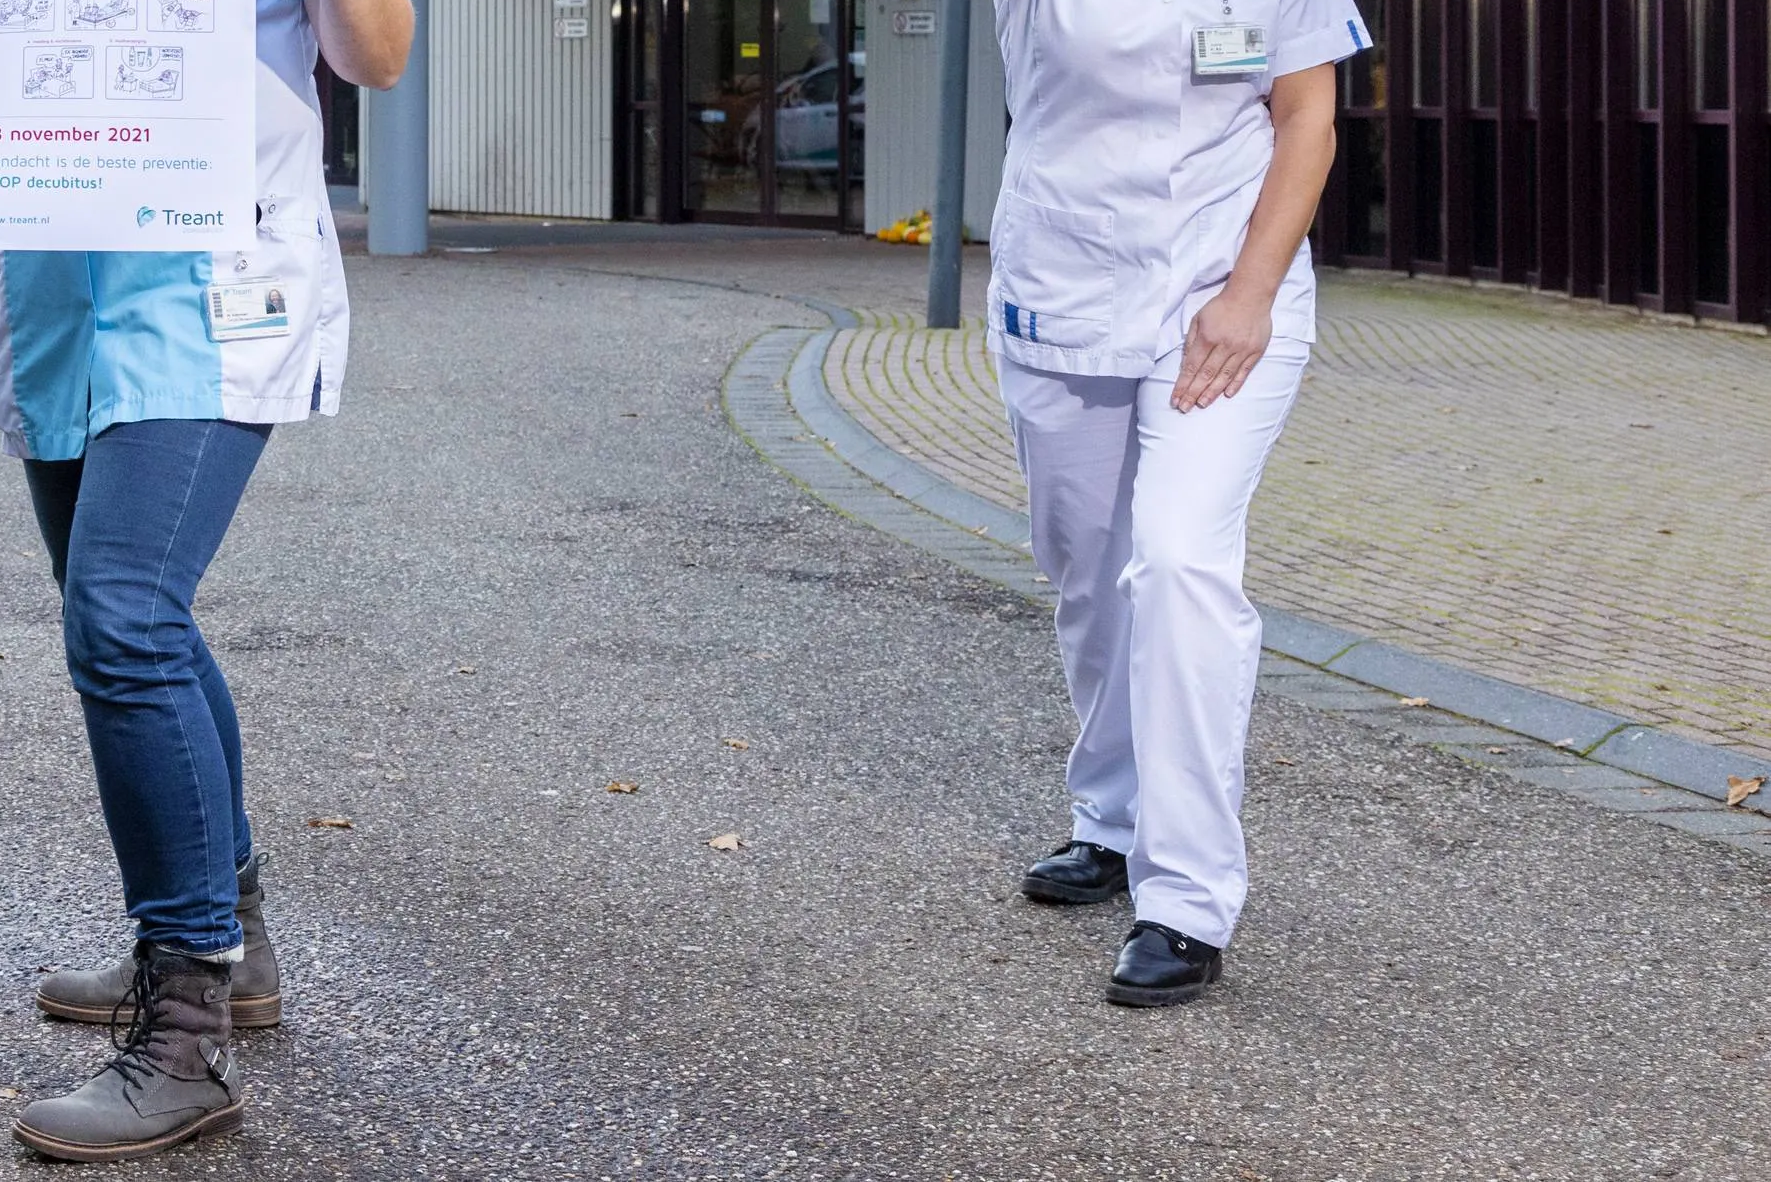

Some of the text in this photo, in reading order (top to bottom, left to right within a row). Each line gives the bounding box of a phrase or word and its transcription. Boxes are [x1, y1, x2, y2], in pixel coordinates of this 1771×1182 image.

[10, 127, 100, 141] november
[108, 127, 150, 142] 2021
[56, 157, 67, 168] is
[73, 156, 91, 168] de
[97, 156, 136, 169] beste
[142, 158, 213, 171] preventie:
[27, 176, 103, 189] decubitus!
[162, 209, 224, 226] Treant
